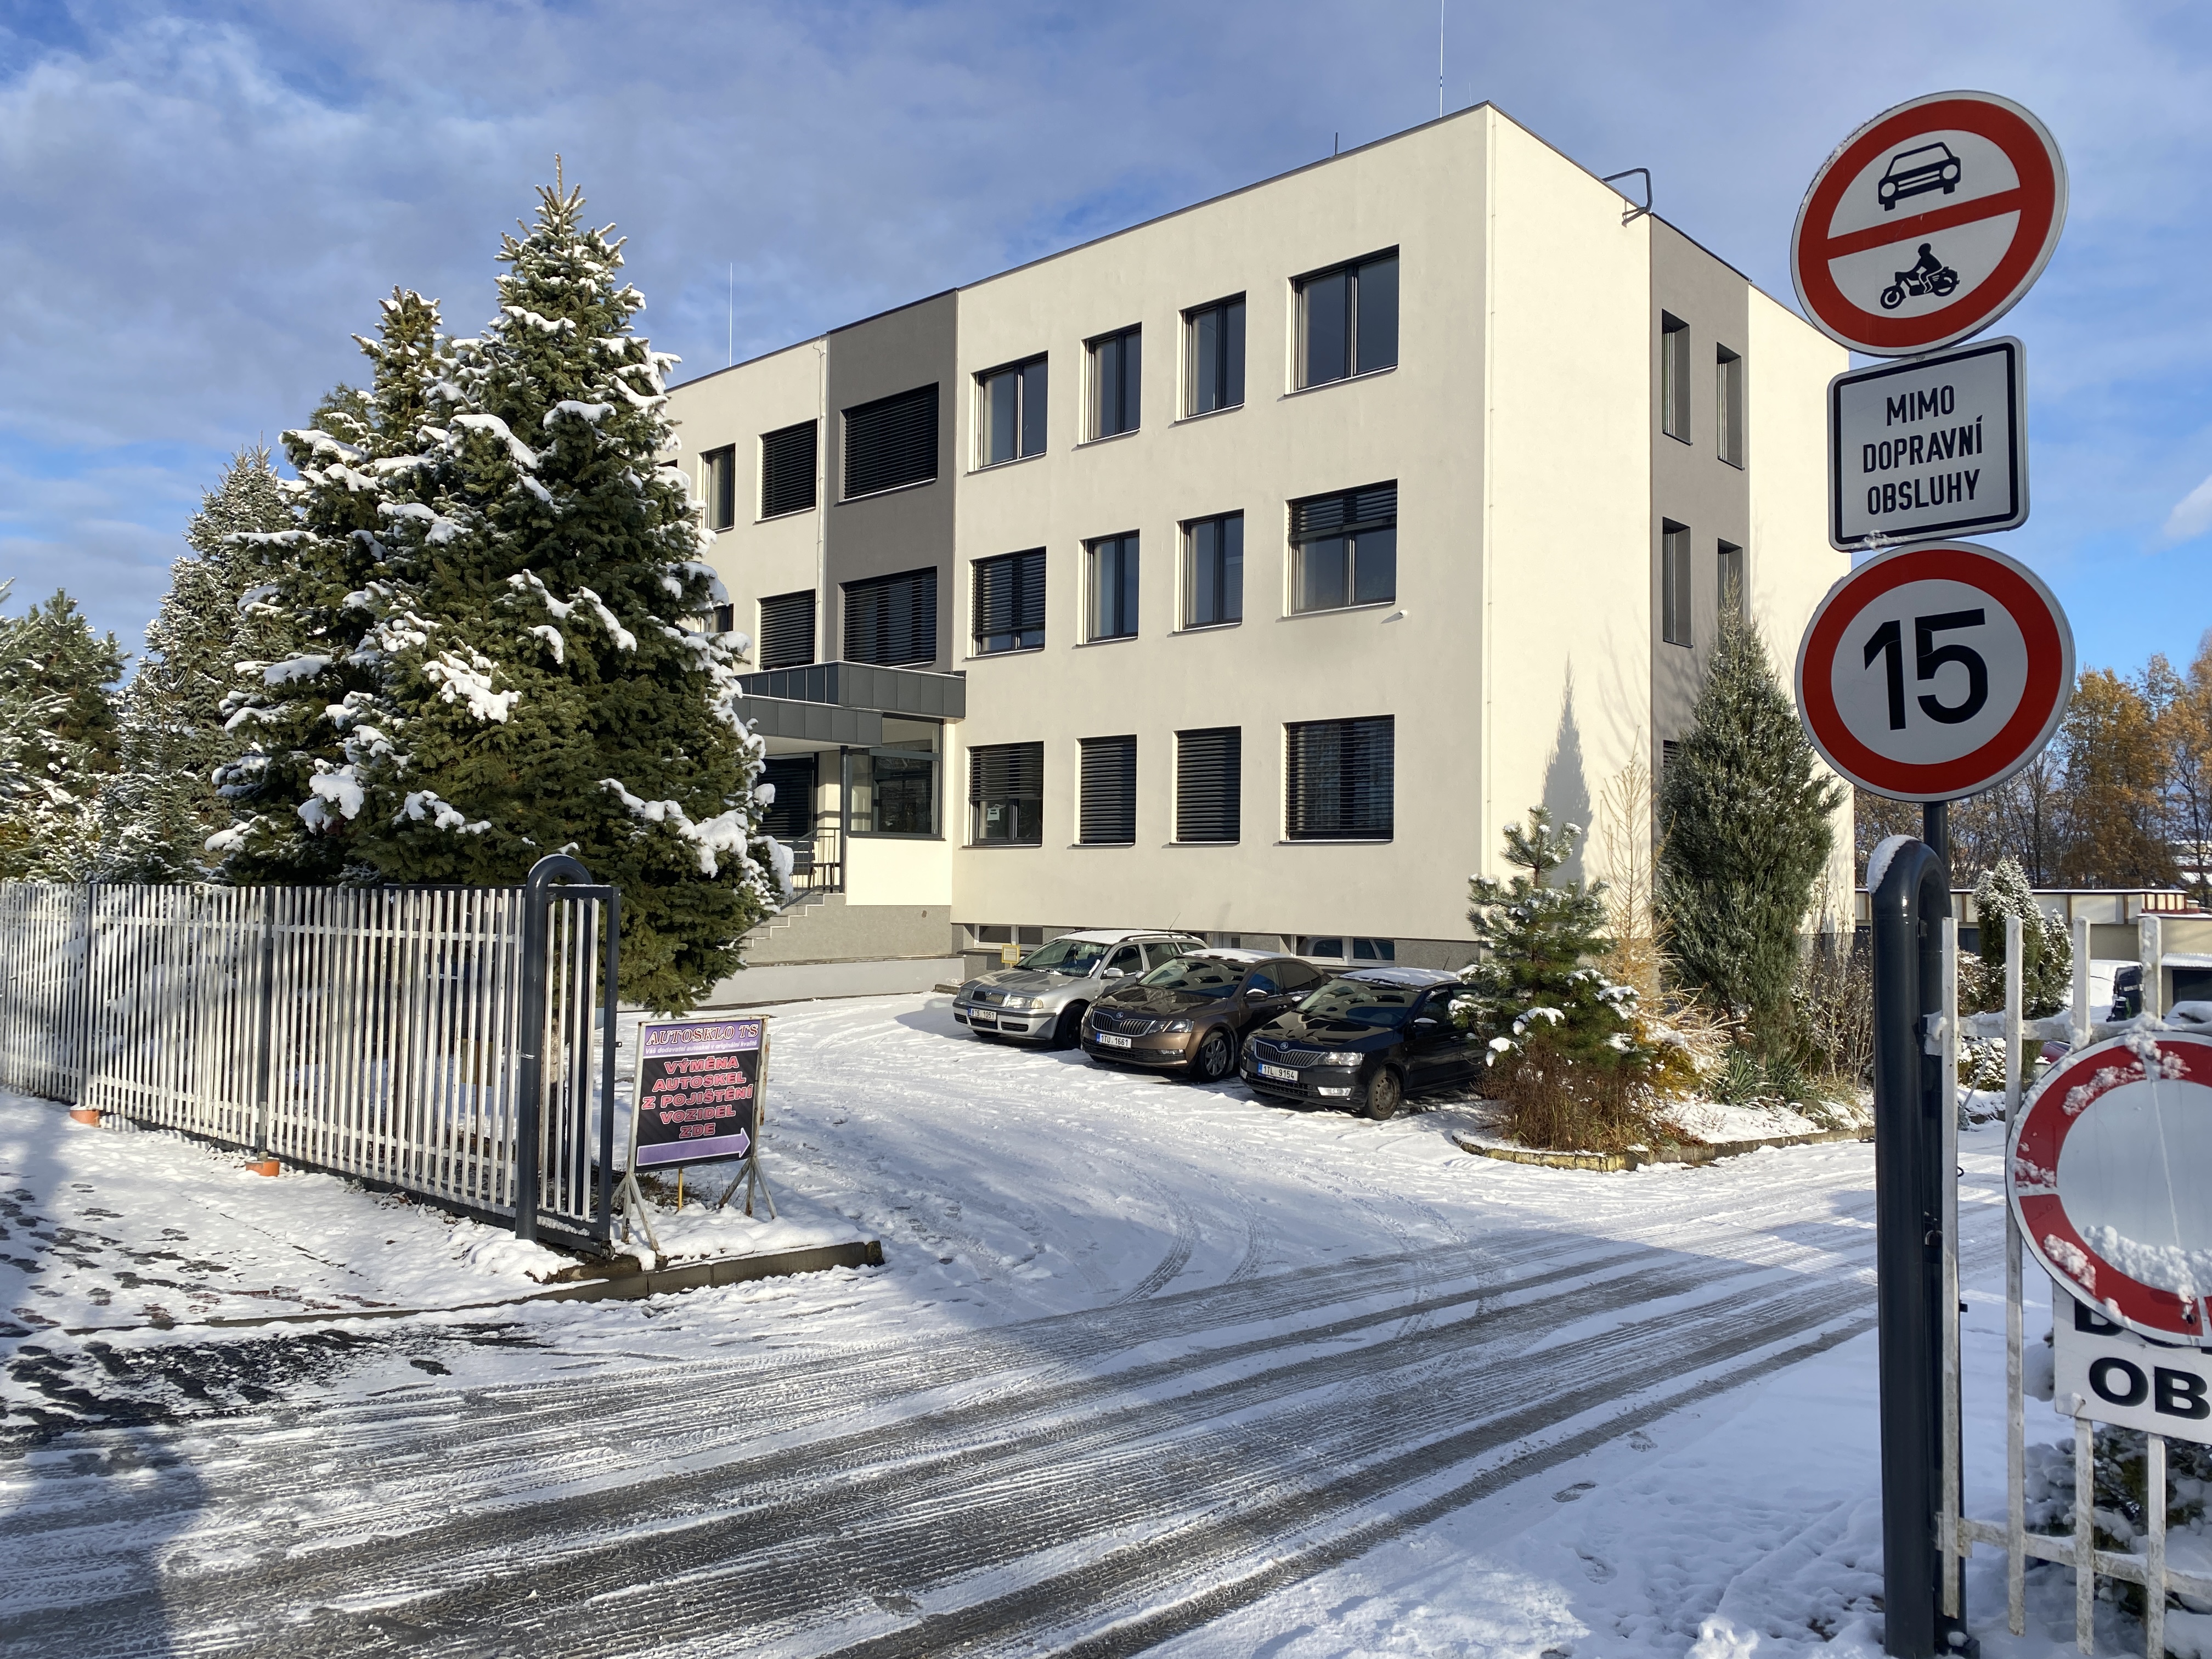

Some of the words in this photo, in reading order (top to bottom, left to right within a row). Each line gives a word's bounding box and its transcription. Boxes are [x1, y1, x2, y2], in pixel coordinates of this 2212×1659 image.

[1886, 385, 1955, 426] MIMO
[1863, 414, 1983, 473] DOPRAVNÍ
[1867, 469, 1980, 515] OBSLUHY
[1864, 608, 1988, 730] 15
[983, 1011, 994, 1019] 1051
[646, 1025, 735, 1046] AUTOSKLO
[739, 1024, 759, 1038] TS
[1101, 1035, 1111, 1043] 1TU
[1115, 1037, 1128, 1046] 1661
[657, 1045, 686, 1053] dodavatel
[715, 1041, 740, 1050] originální
[664, 1056, 740, 1074] VÝMĚNA
[1263, 1066, 1274, 1075] 1TL
[1279, 1069, 1294, 1079] 9154
[652, 1071, 746, 1092] AUTOSKEL
[641, 1096, 656, 1110] Z
[661, 1084, 754, 1108] POJIŠTĚNÍ
[660, 1104, 736, 1124] VOZIDEL
[679, 1122, 715, 1138] ZDE
[2089, 1357, 2211, 1420] OB
